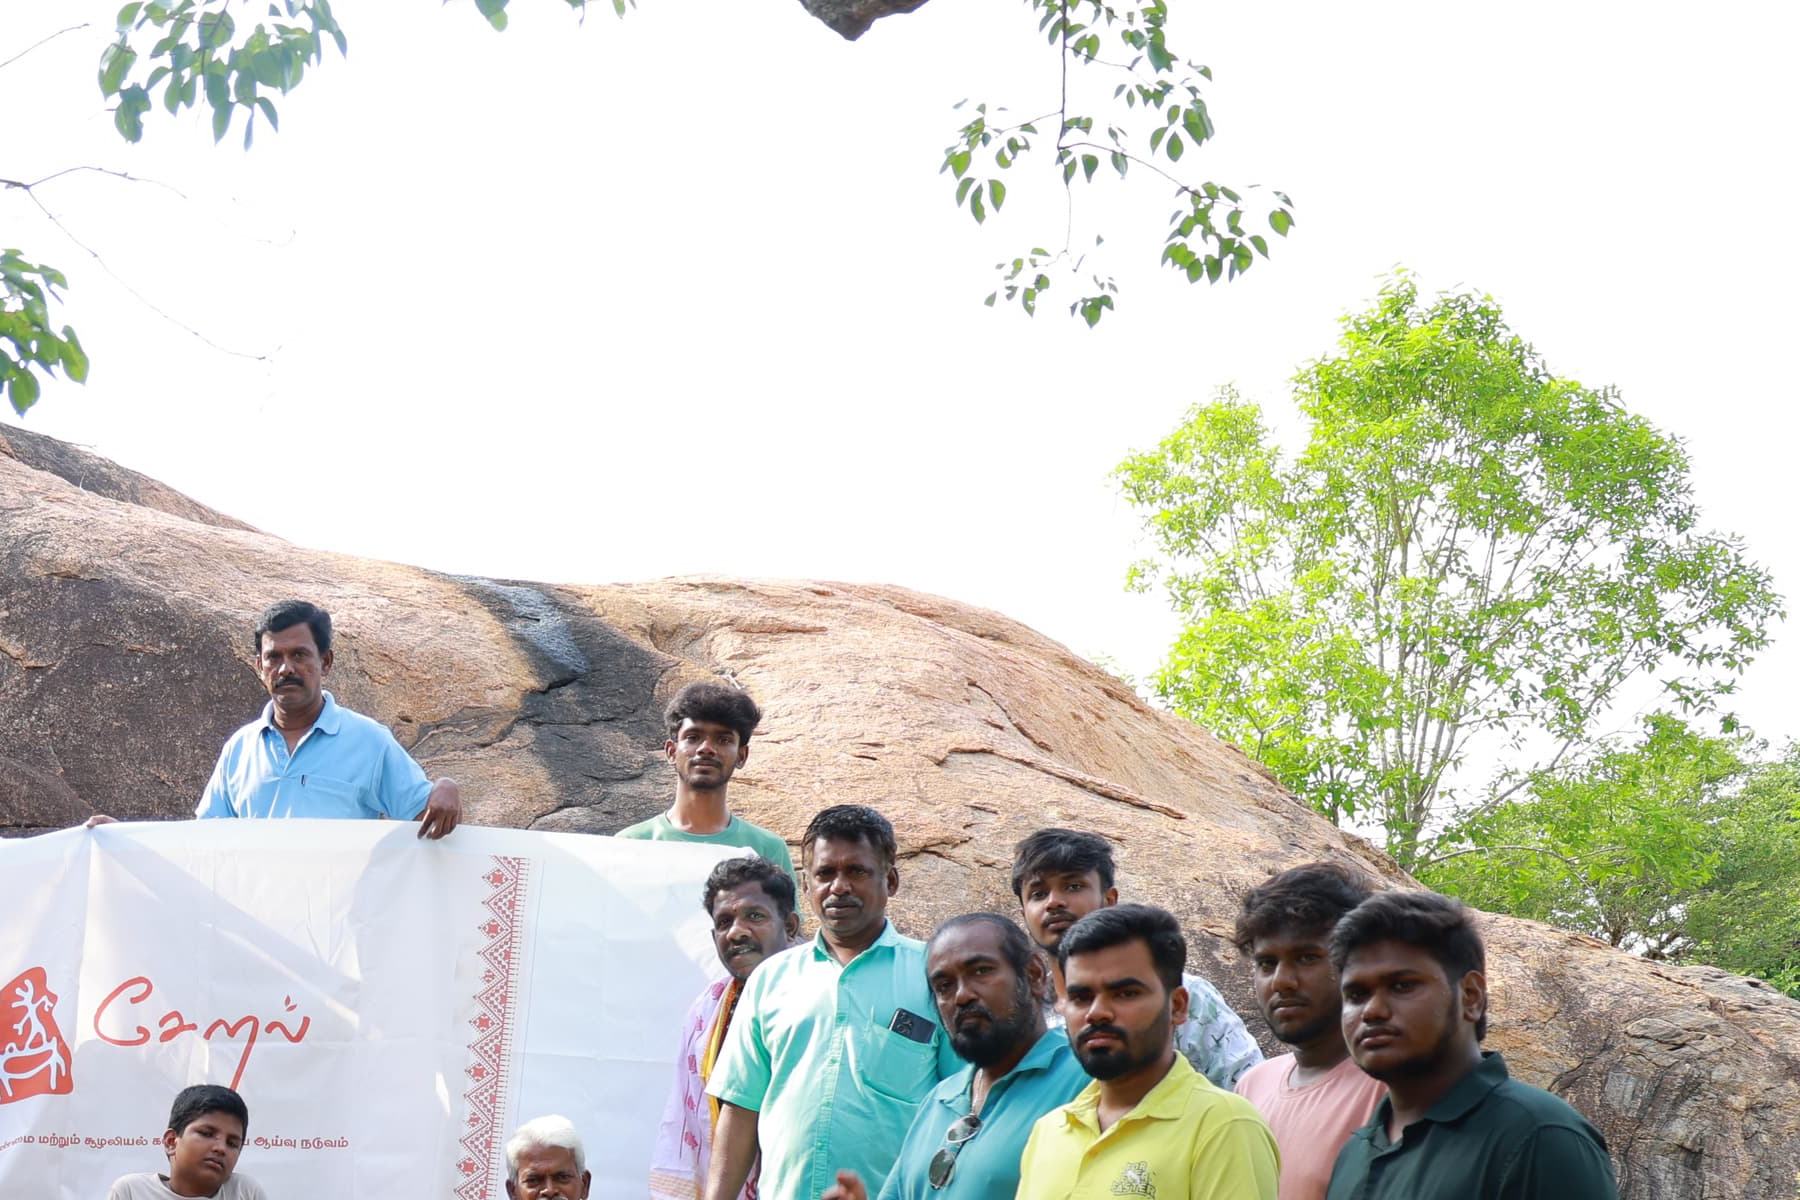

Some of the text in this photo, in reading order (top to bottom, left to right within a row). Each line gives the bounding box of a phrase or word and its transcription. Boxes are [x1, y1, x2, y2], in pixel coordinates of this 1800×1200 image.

[38, 1132, 81, 1148] மற்றும்
[253, 1135, 297, 1150] ஆய்வு
[300, 1136, 349, 1149] நடுவம்
